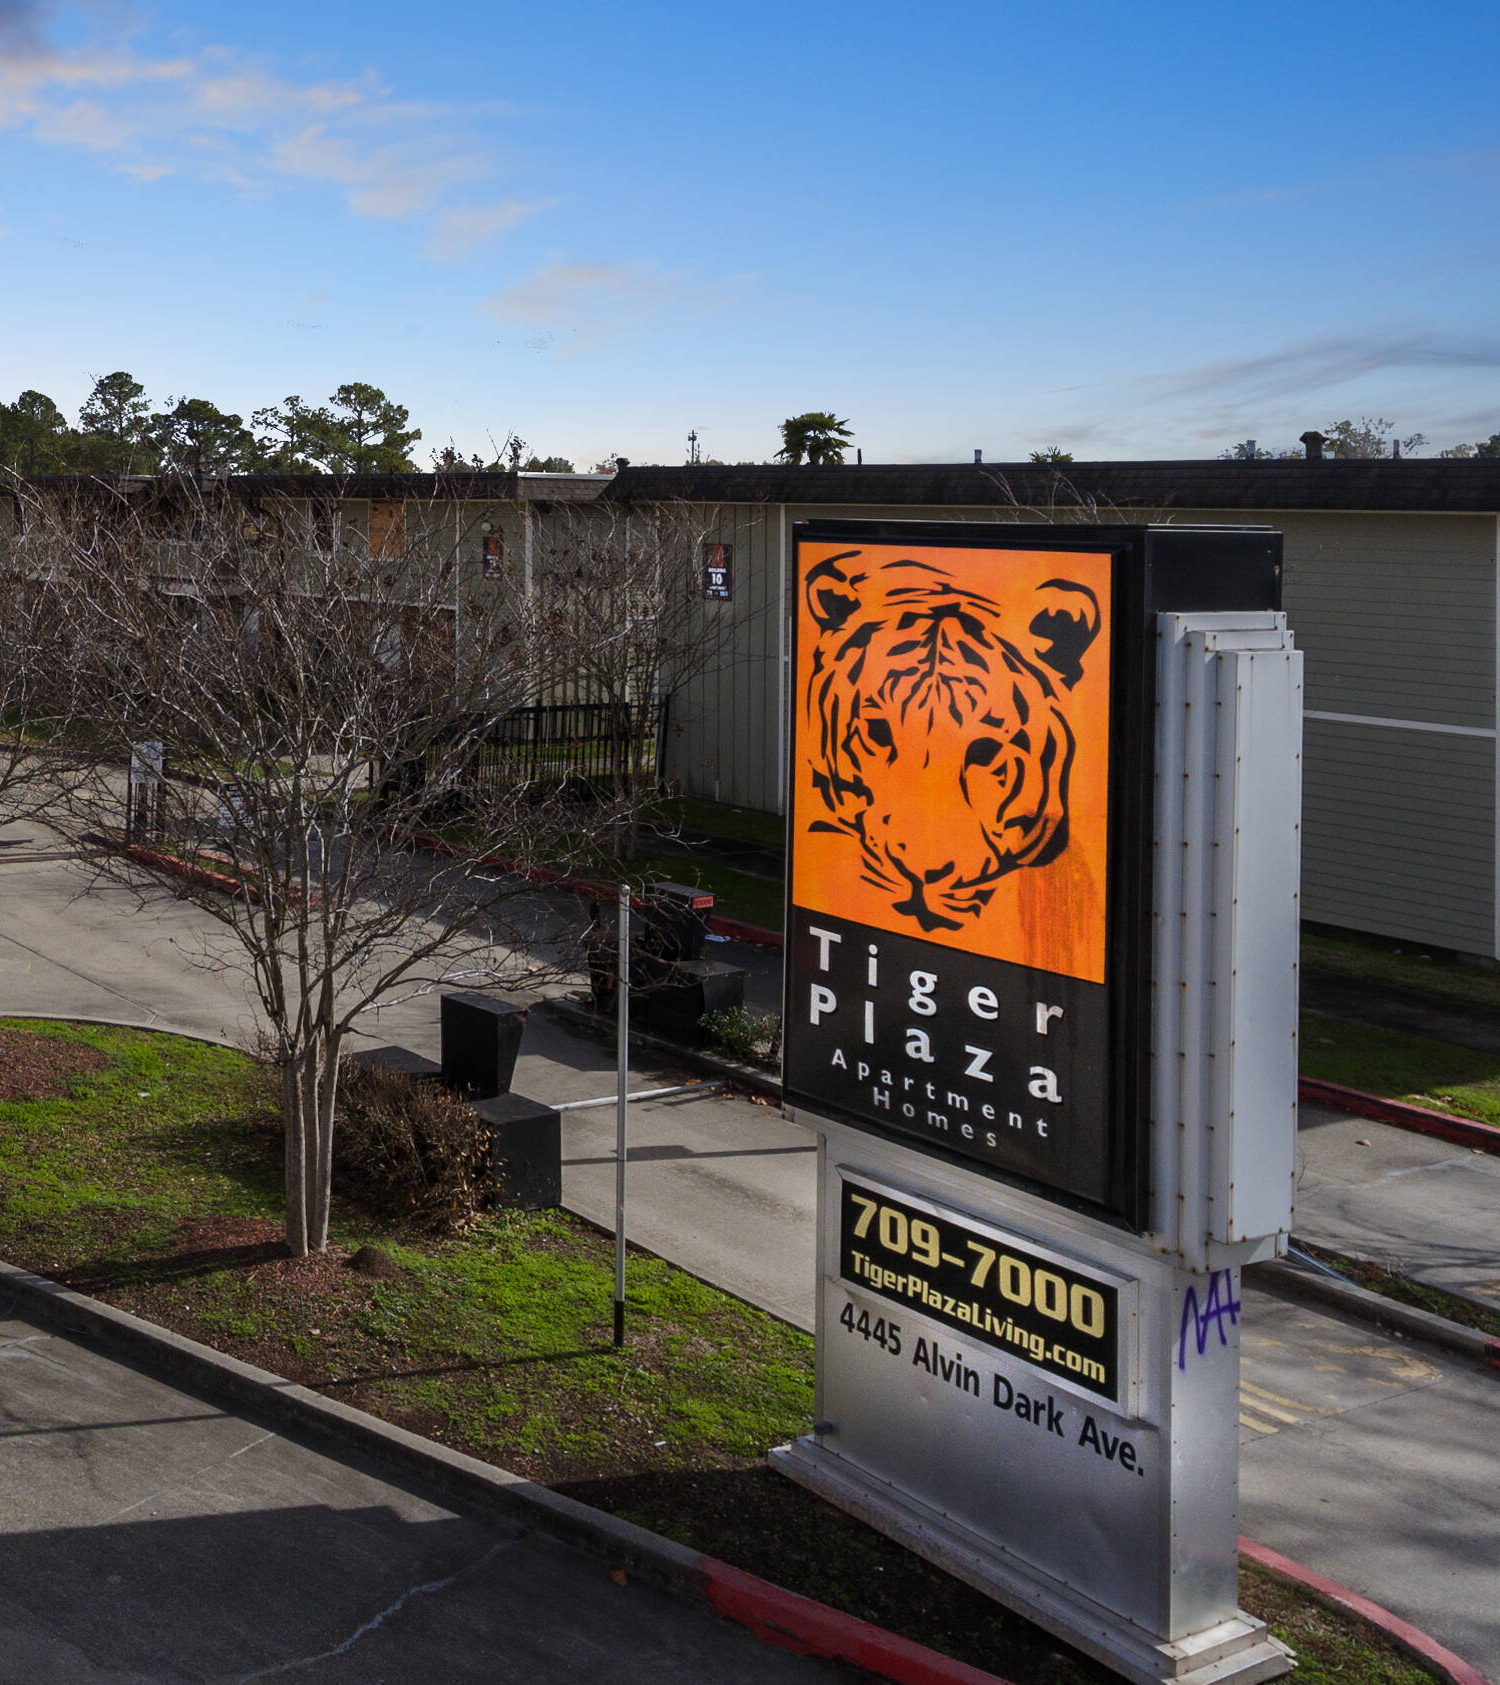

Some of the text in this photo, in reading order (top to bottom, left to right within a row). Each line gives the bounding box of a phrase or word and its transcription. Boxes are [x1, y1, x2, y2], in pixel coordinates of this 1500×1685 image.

[712, 573, 723, 585] 10
[809, 926, 1063, 1035] Tiger
[809, 983, 1062, 1103] Plaza
[831, 1048, 1048, 1137] Apartment
[873, 1086, 996, 1147] Homes
[851, 1193, 1105, 1339] 709-7000
[851, 1250, 1106, 1384] TigerPlazaLiving.com
[840, 1302, 1144, 1477] 4445 Alvin Dark Ave.
